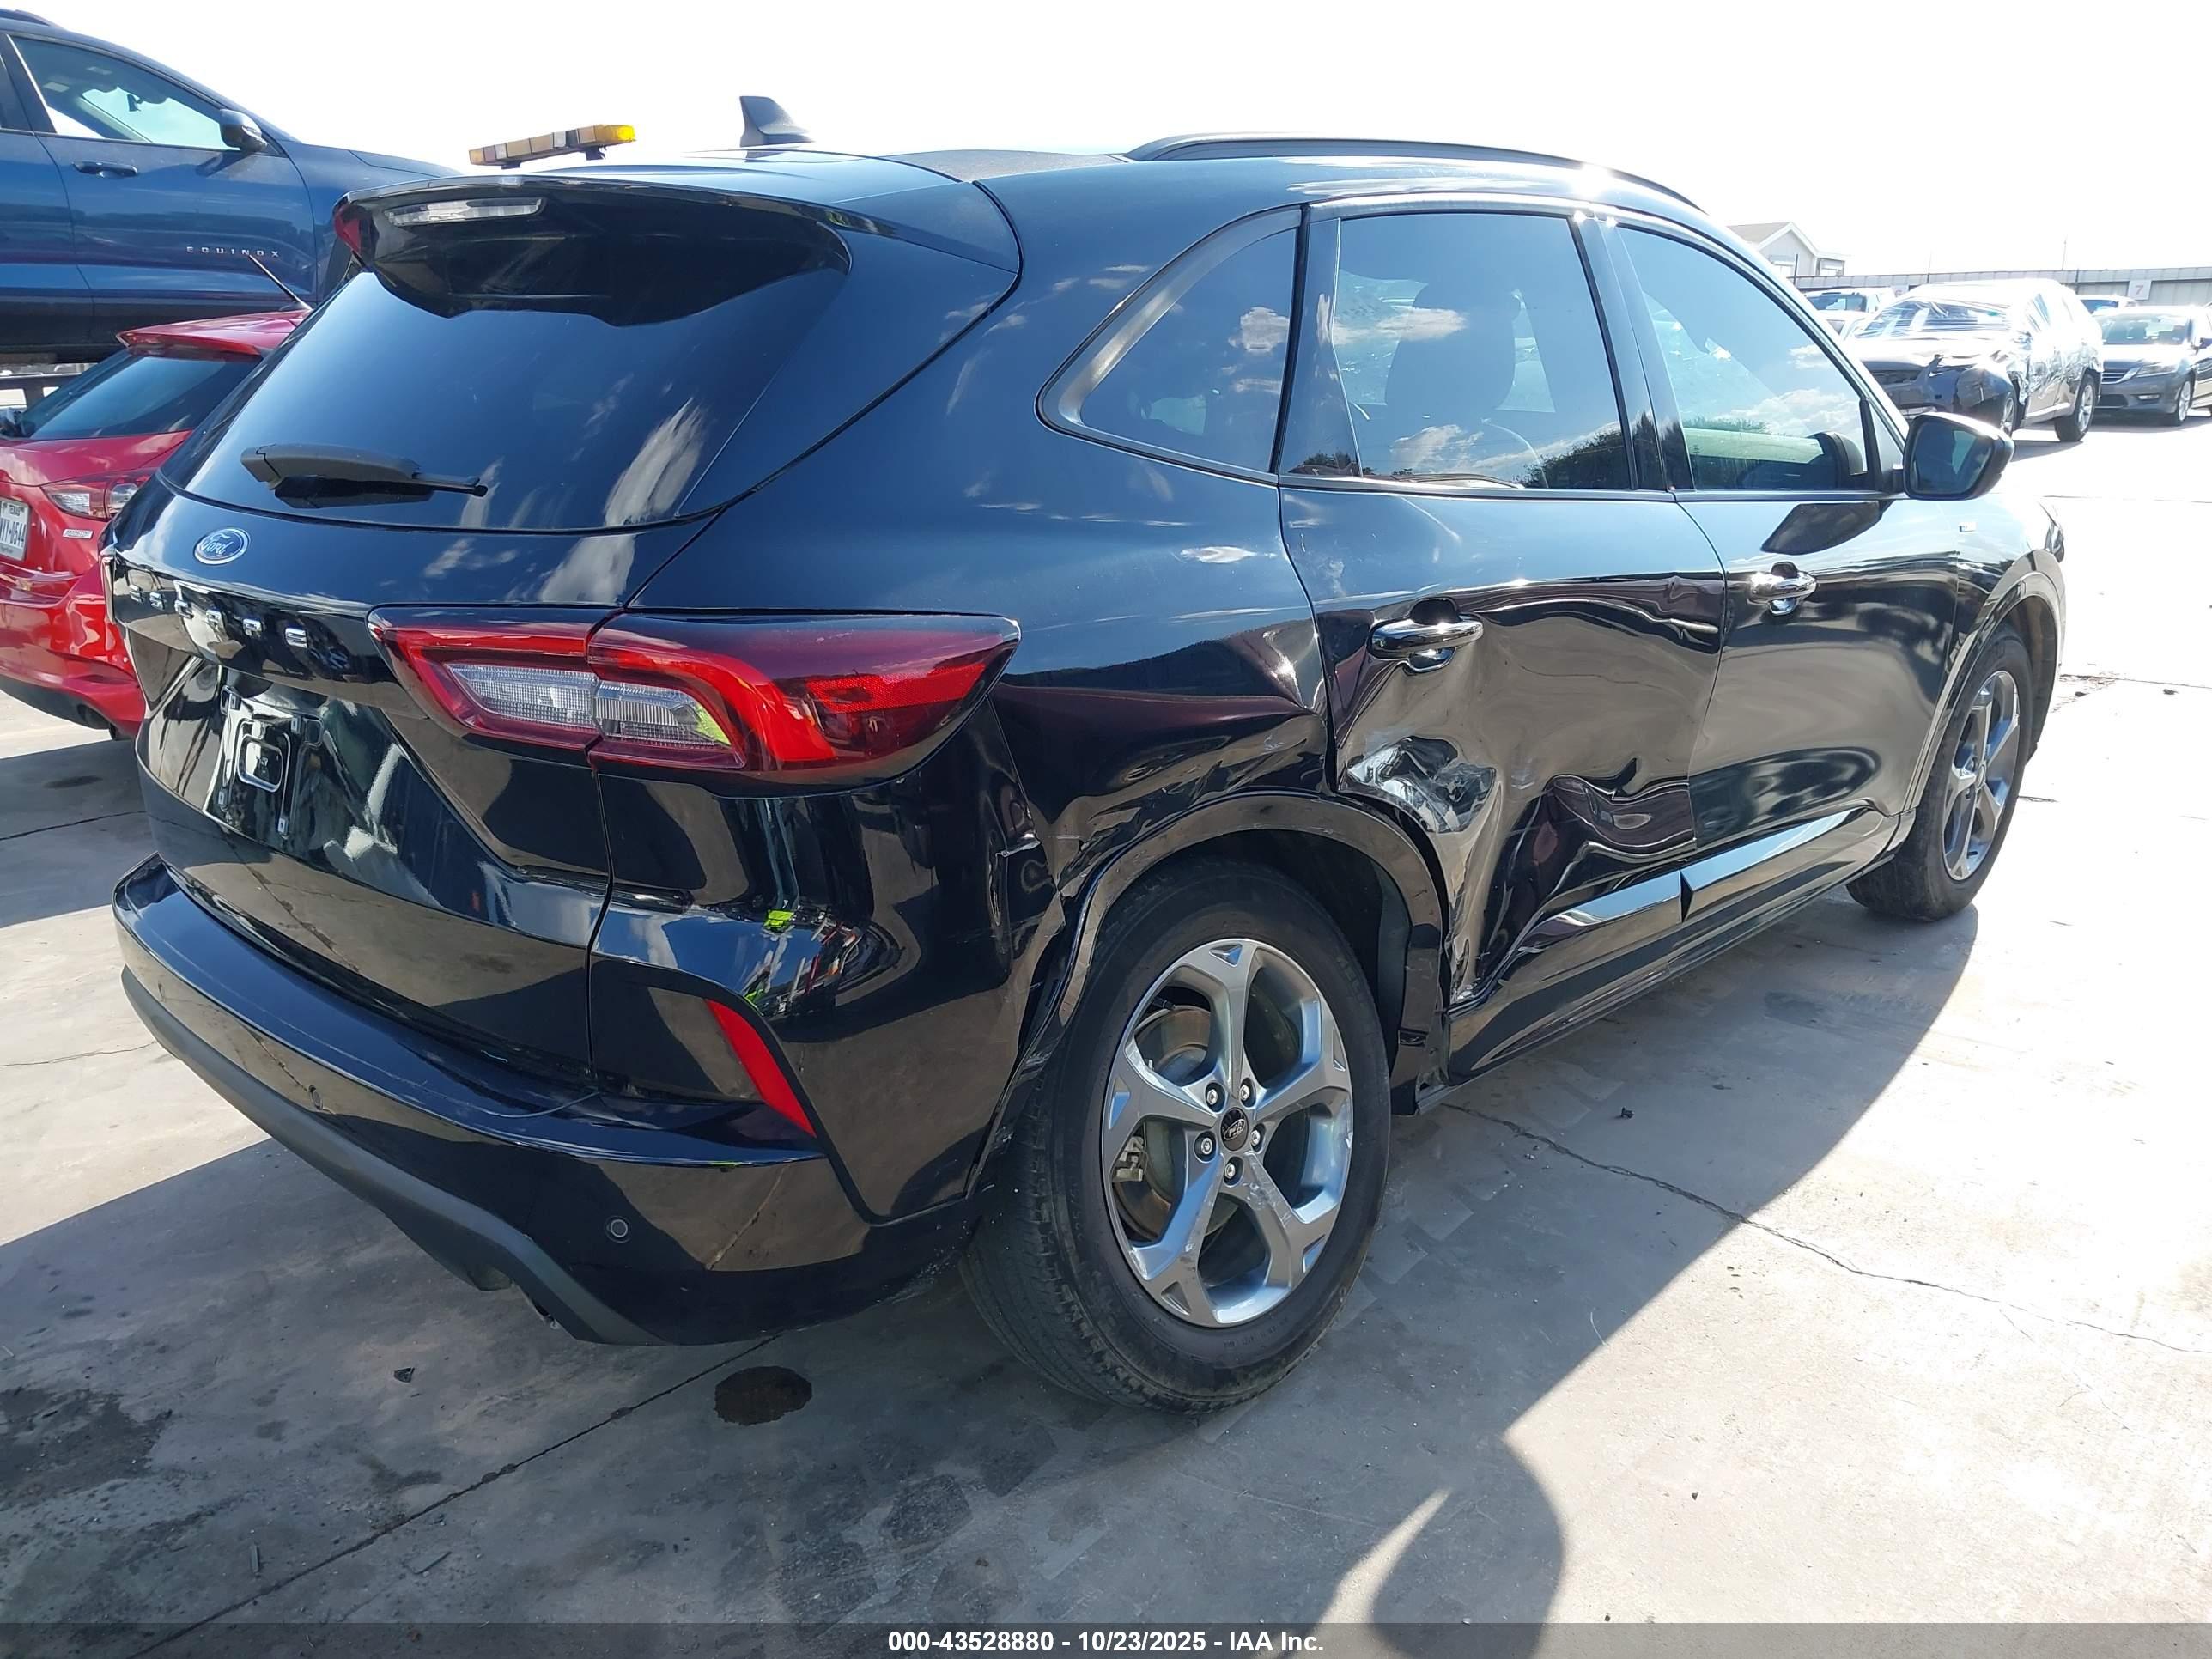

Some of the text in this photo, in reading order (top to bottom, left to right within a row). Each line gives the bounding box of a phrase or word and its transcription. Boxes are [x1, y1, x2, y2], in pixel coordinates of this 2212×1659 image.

[186, 246, 279, 258] EQUINOX
[2136, 284, 2144, 295] 7
[200, 532, 234, 555] Ford
[128, 584, 309, 649] ESCAPE
